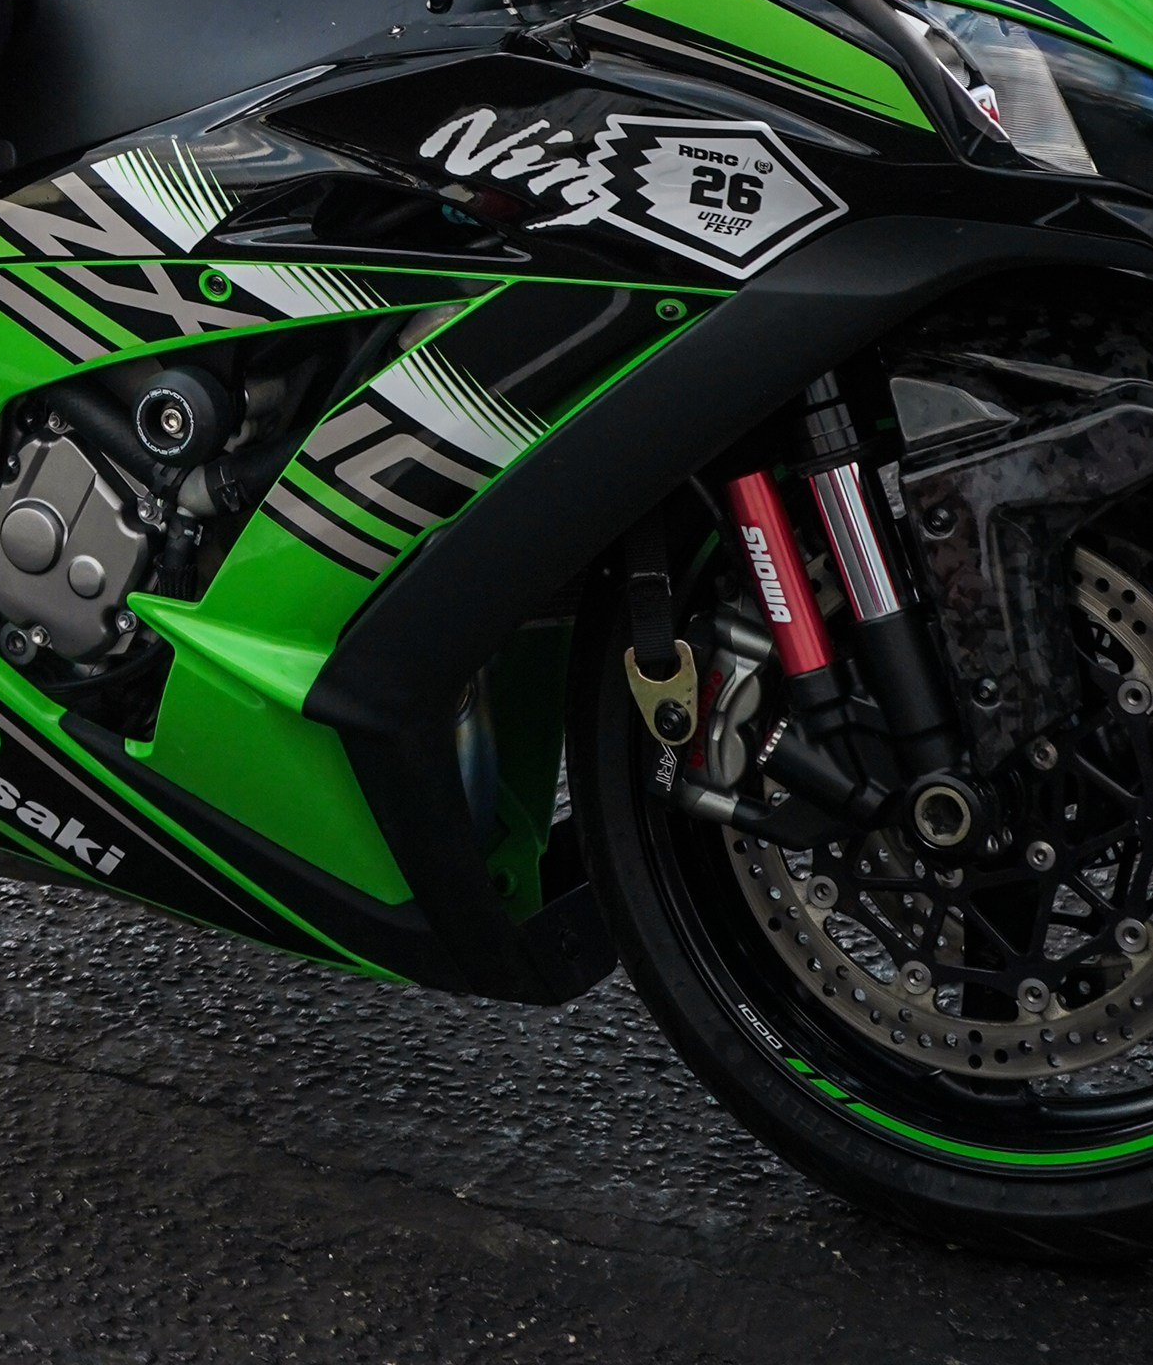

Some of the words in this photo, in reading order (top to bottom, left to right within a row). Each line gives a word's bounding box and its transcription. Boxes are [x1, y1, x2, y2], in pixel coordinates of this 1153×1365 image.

[679, 144, 739, 166] RDRC
[689, 165, 764, 214] 26
[698, 211, 752, 228] UNLIM
[704, 222, 745, 236] FEST
[742, 525, 792, 623] SHOWA
[737, 1003, 783, 1050] 1000
